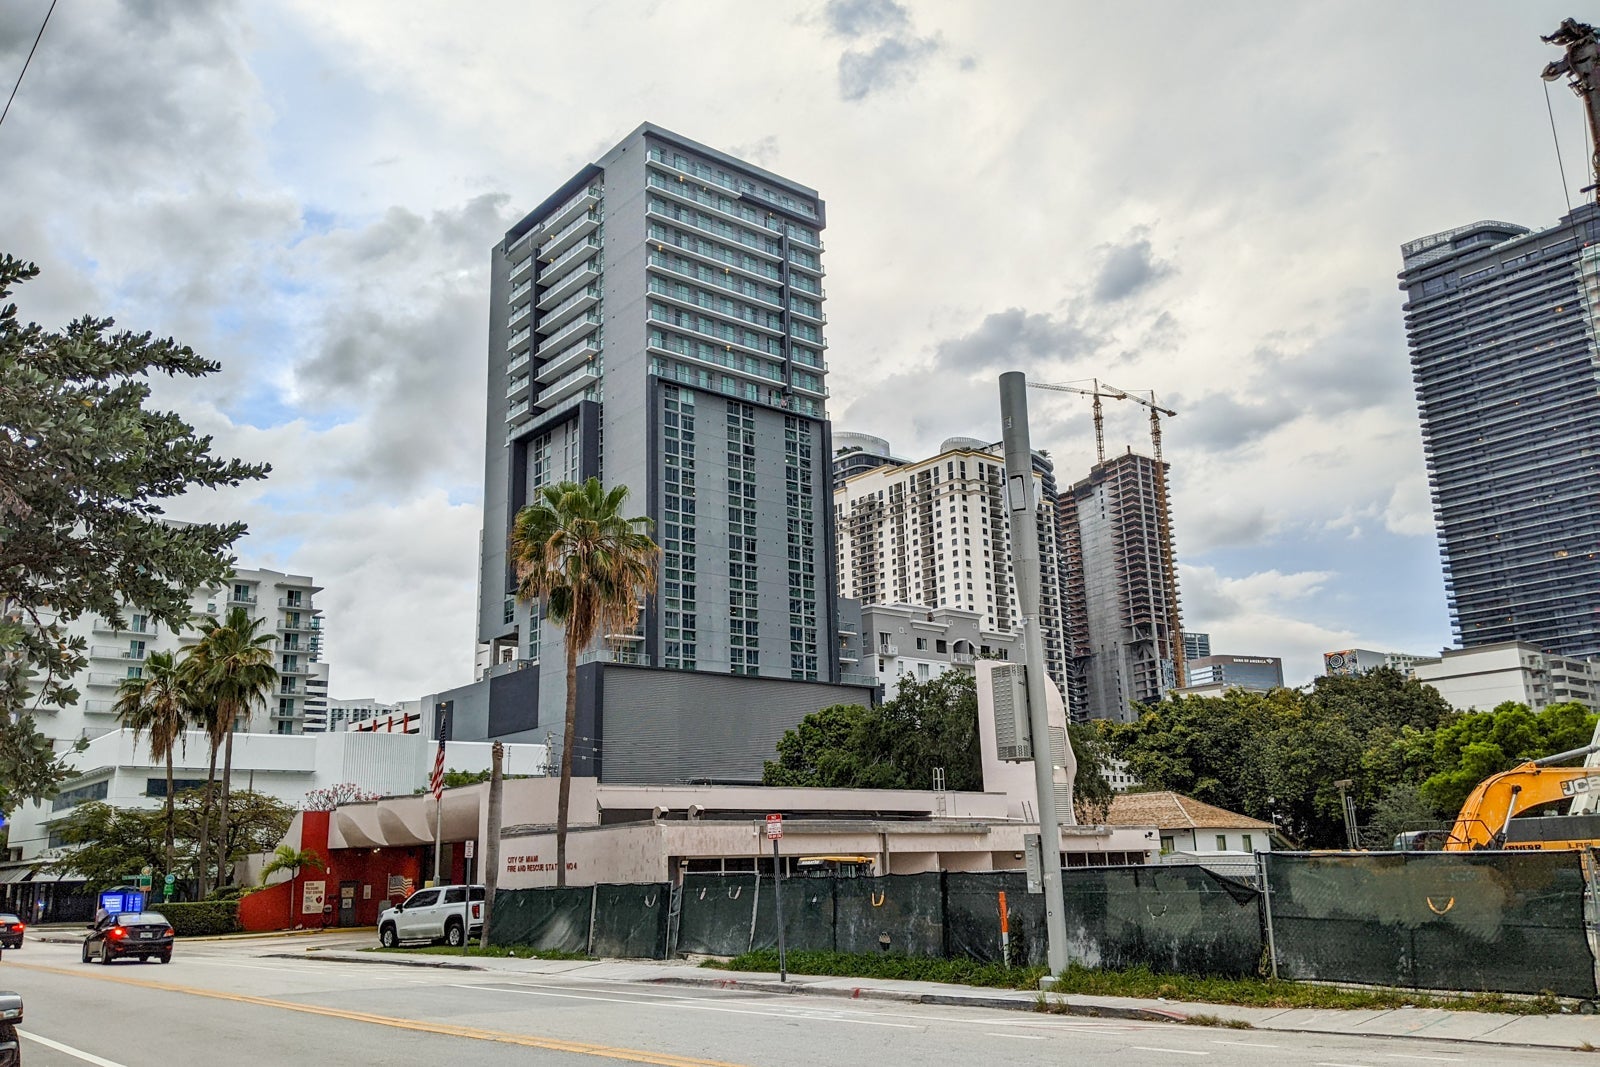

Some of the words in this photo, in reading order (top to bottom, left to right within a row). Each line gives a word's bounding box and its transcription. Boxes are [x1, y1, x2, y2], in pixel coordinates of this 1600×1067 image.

[507, 856, 517, 864] CITY
[525, 855, 539, 863] MIAMI
[527, 864, 544, 872] RESCUE
[545, 863, 558, 872] STAT
